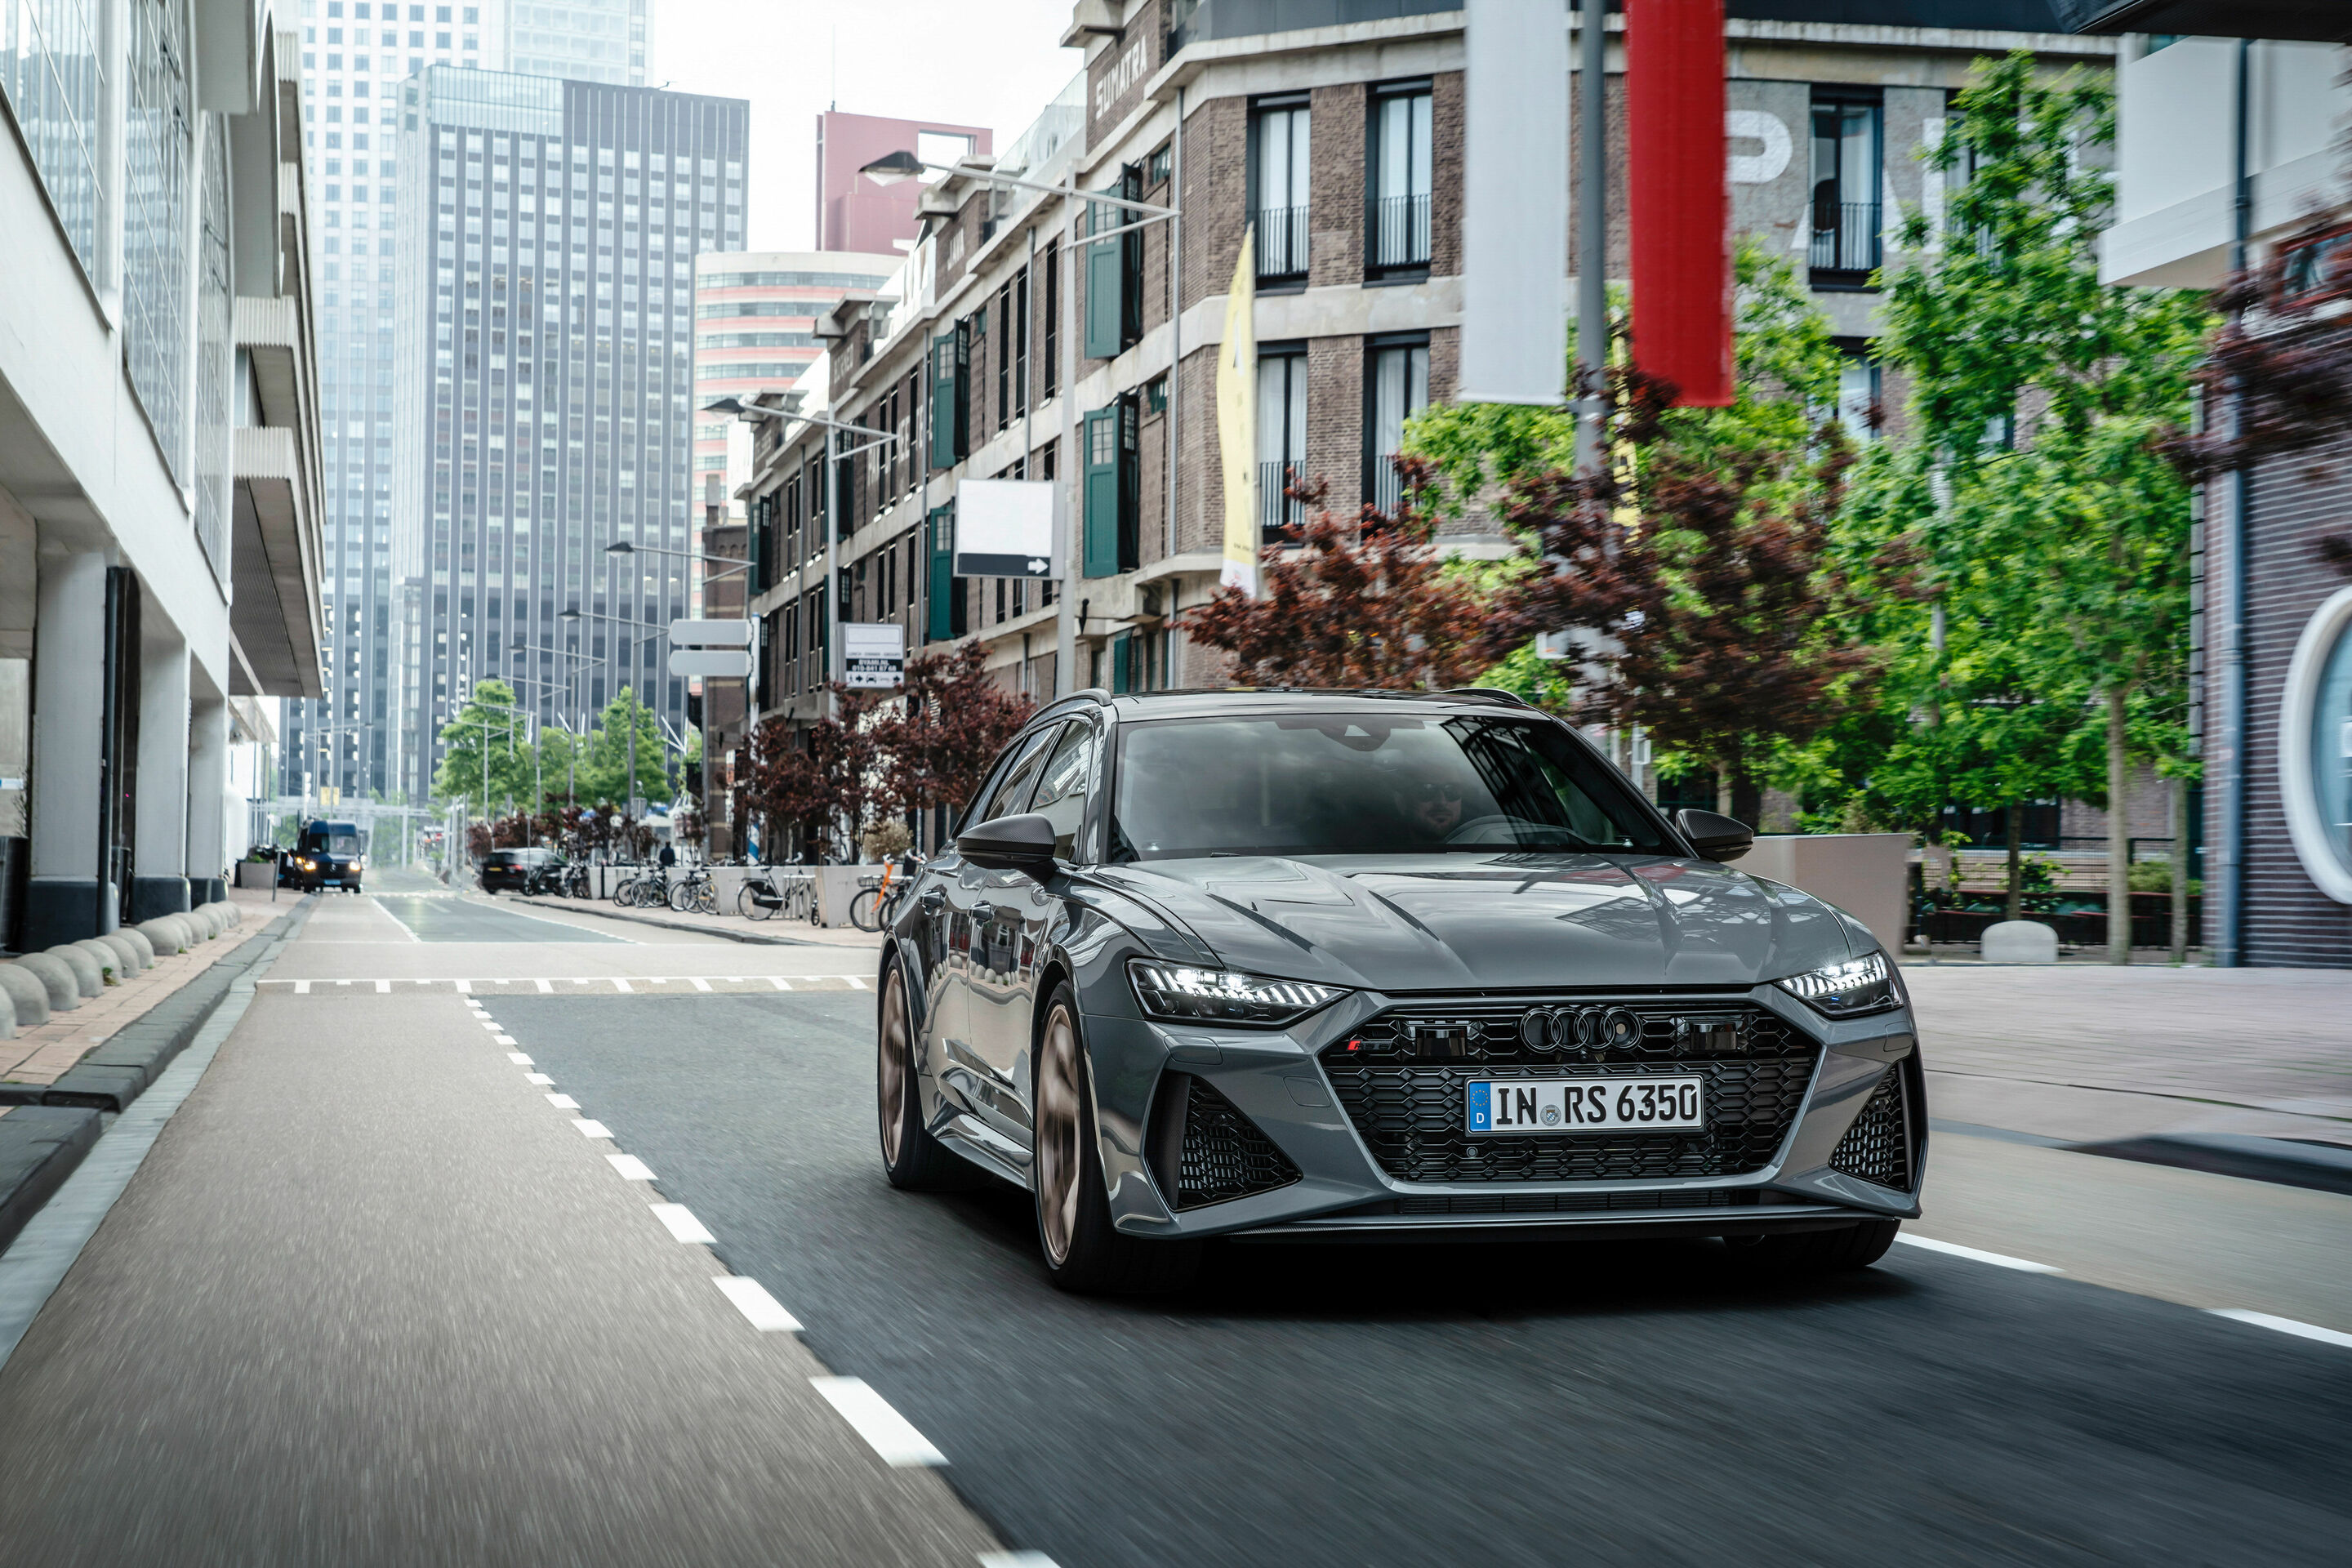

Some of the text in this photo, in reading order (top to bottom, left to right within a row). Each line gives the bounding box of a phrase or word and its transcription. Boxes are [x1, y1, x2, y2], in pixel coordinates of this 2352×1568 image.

[1096, 34, 1147, 121] SUMATRA
[1476, 1084, 1698, 1125] D IN RS 6350
